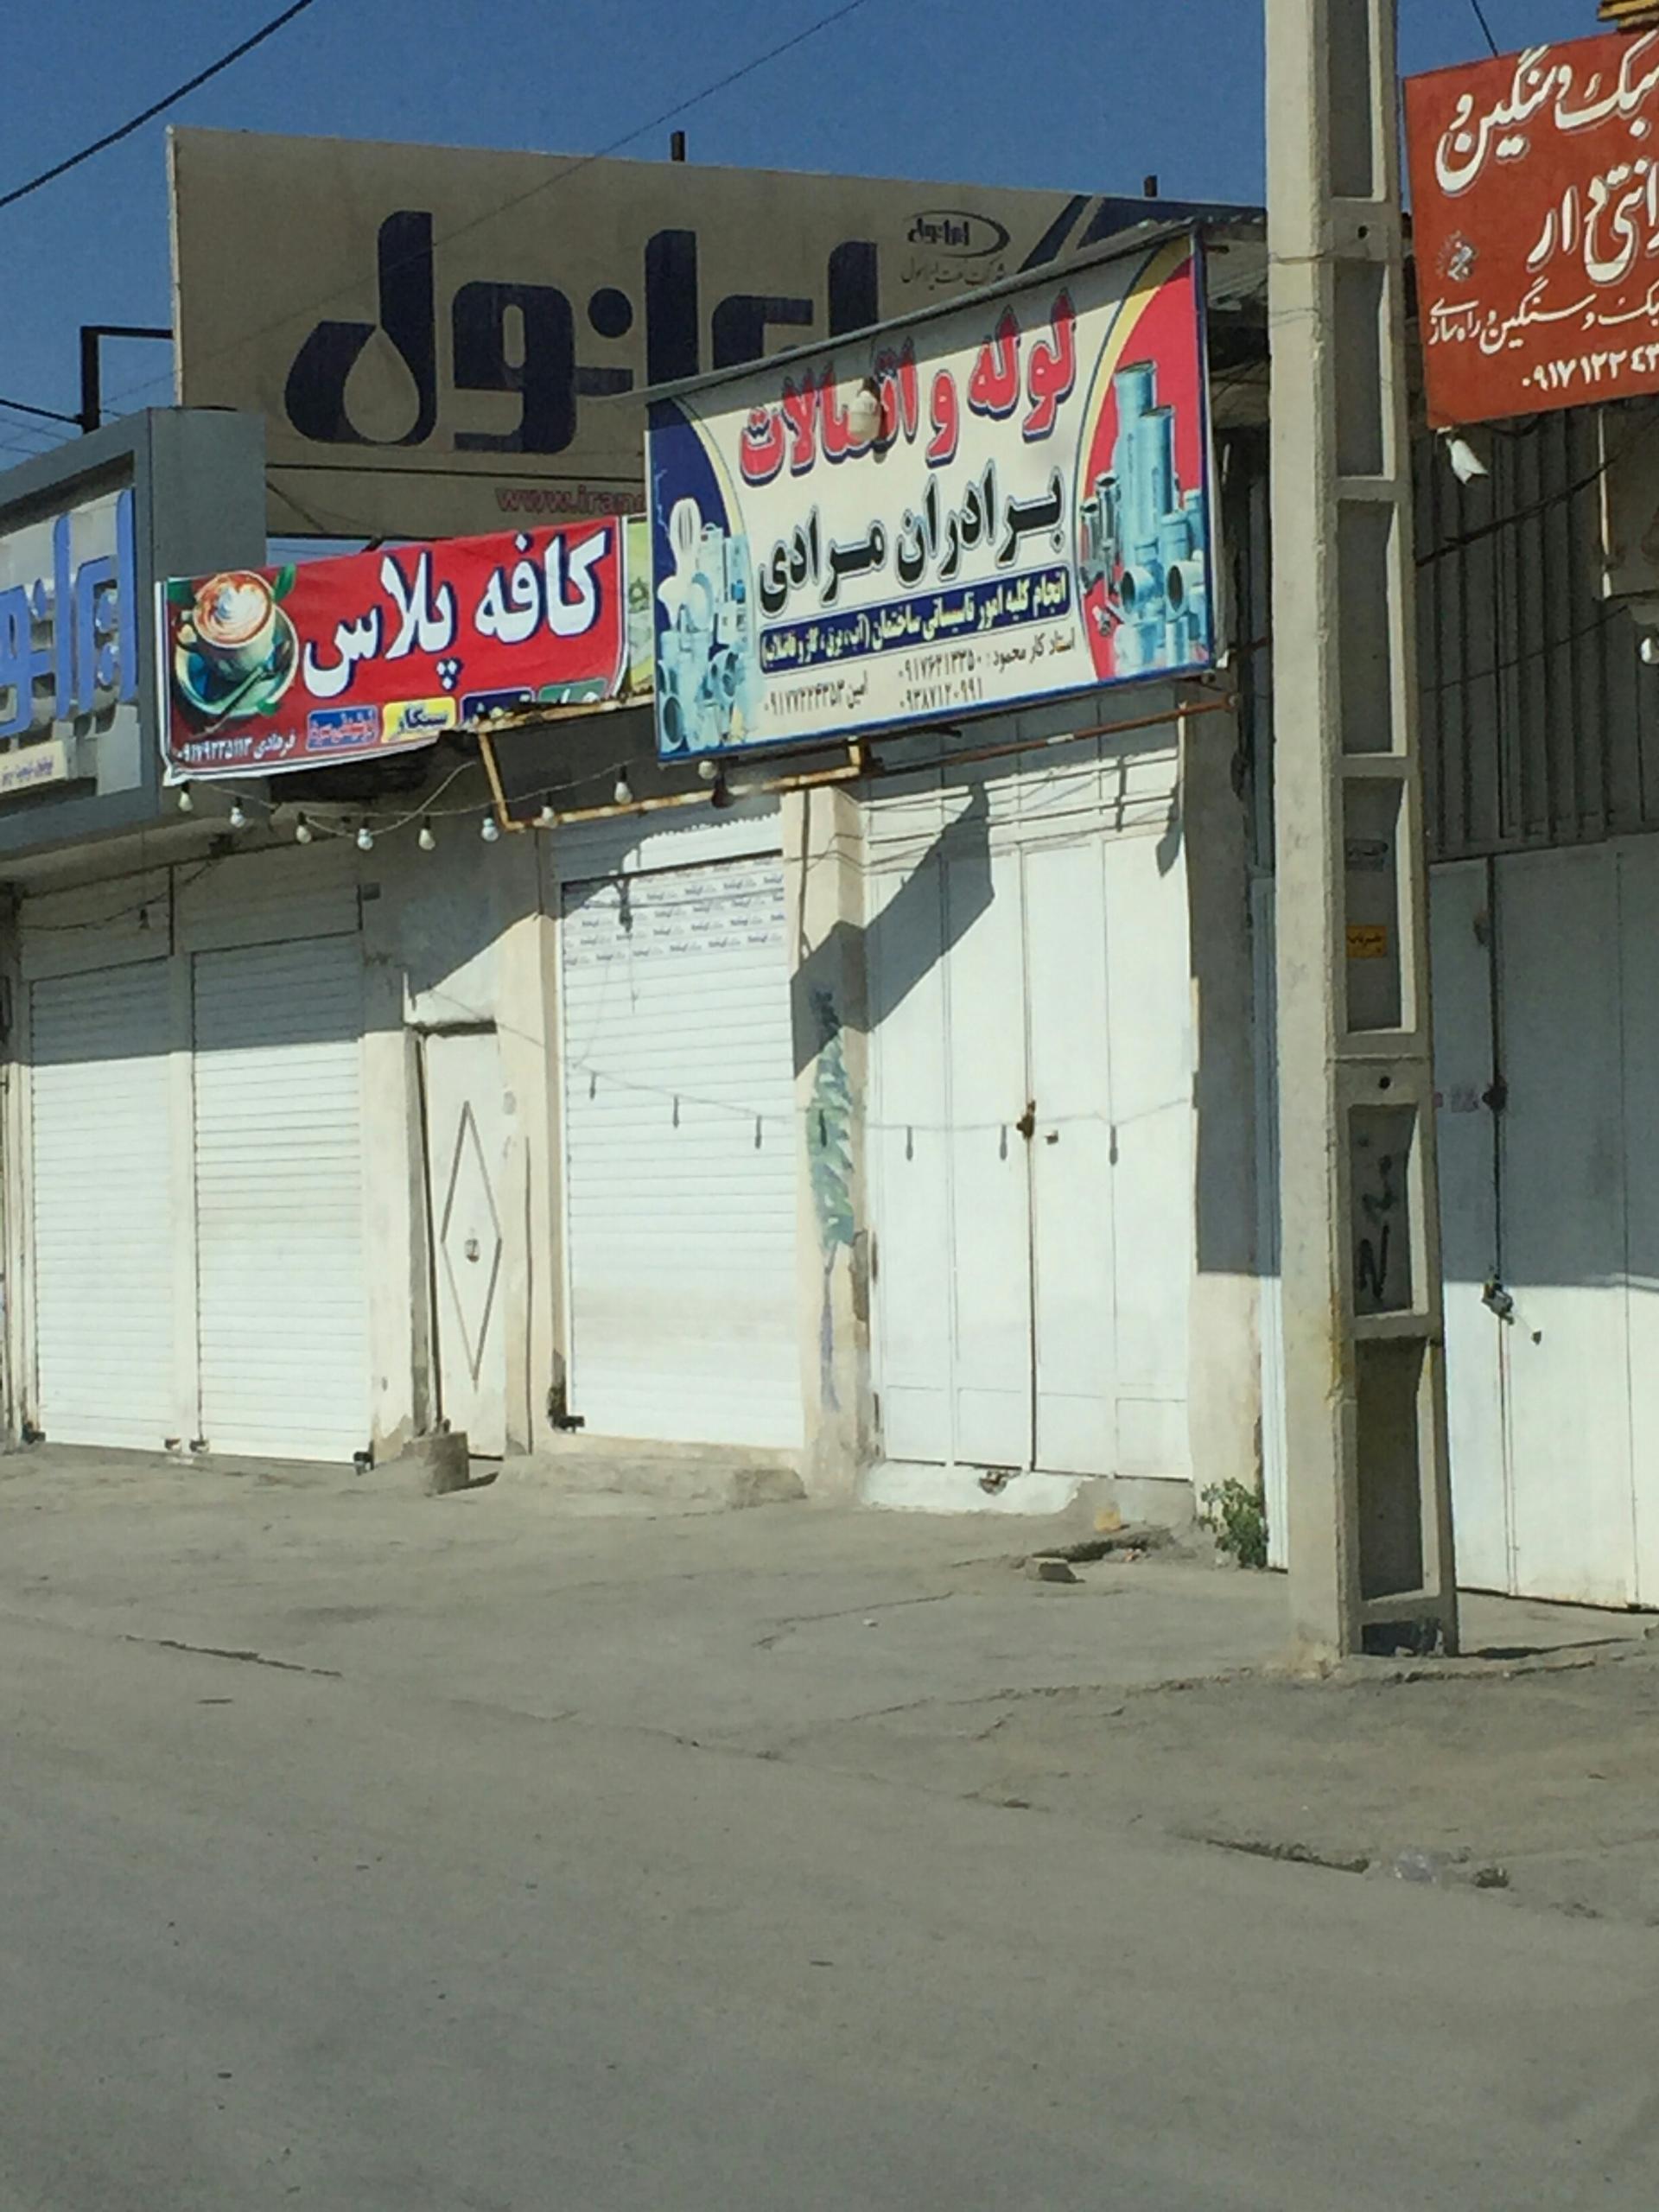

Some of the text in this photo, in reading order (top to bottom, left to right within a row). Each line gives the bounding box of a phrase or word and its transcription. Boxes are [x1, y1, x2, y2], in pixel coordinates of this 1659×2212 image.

[1480, 275, 1597, 354] سنگین
[1599, 281, 1659, 327] بک
[969, 288, 1077, 442] لوله
[926, 370, 959, 467] و
[760, 461, 1065, 614] برادران مرادی
[303, 528, 612, 696] کافه پلاس
[977, 584, 1003, 631] امور
[1005, 578, 1031, 621] کلیه
[1033, 571, 1066, 618] انجام
[872, 605, 922, 651] ساختمان
[1030, 632, 1046, 664] کار
[1049, 626, 1076, 654] استاد
